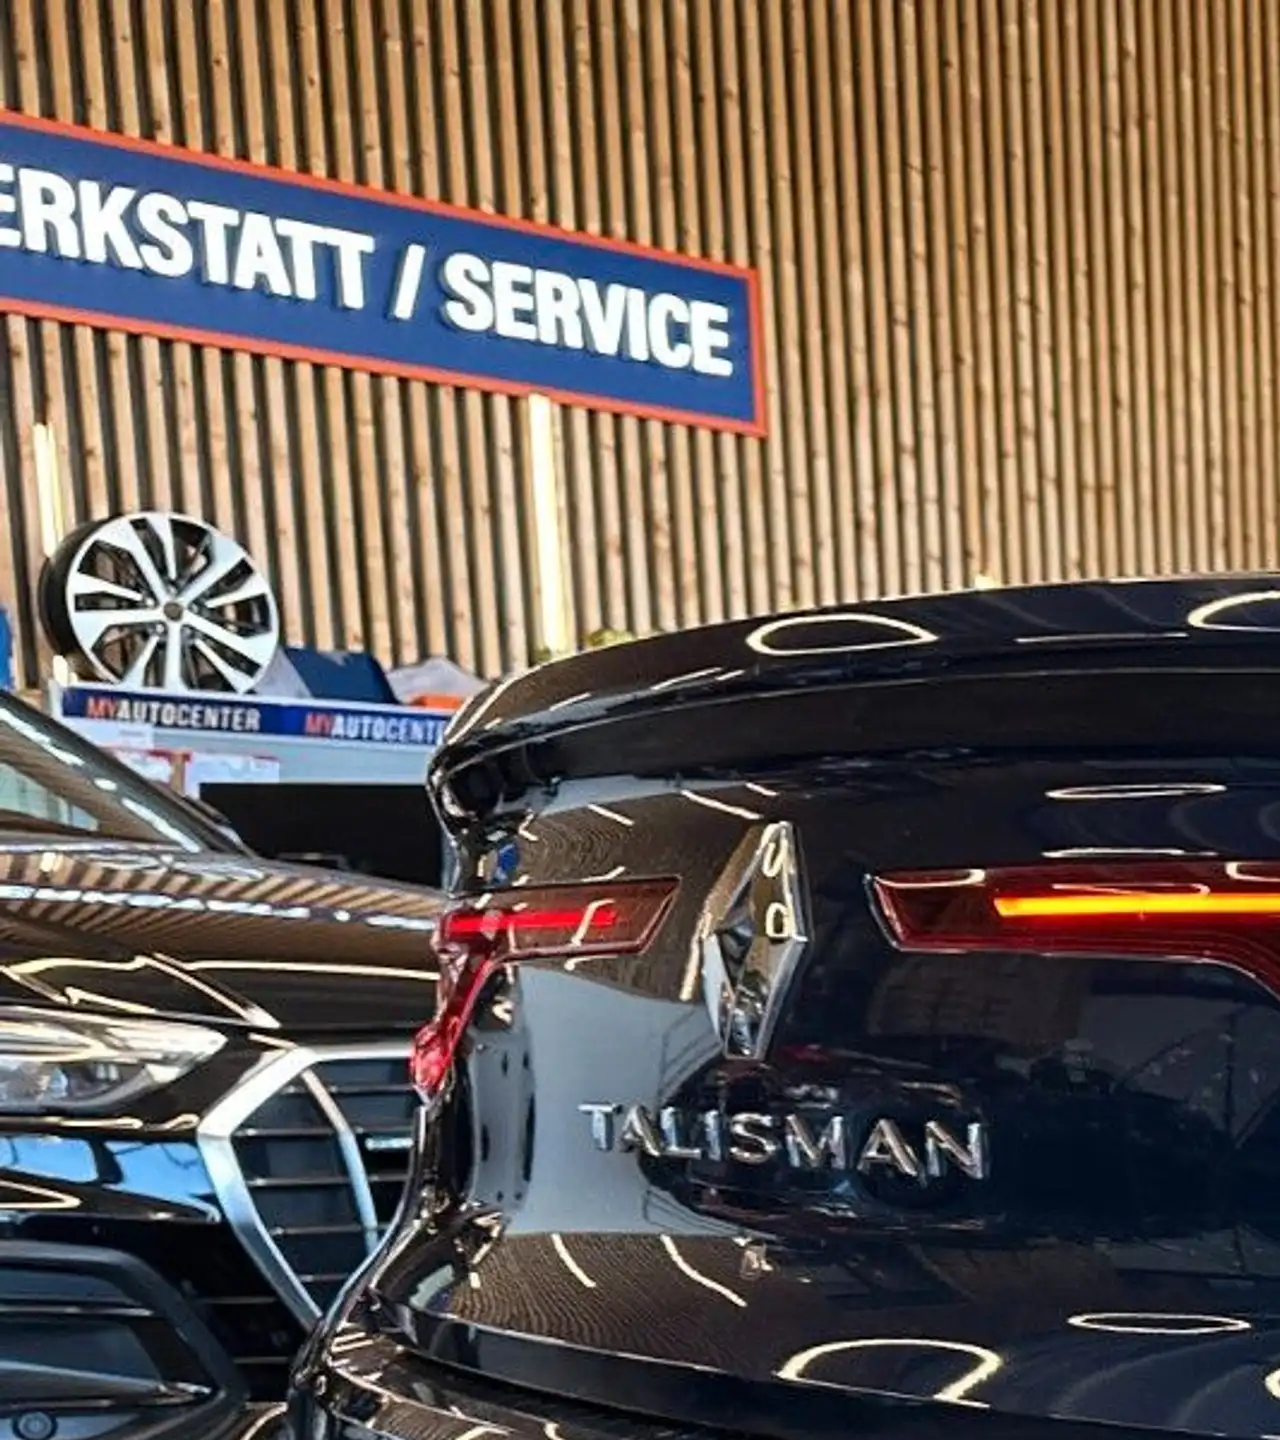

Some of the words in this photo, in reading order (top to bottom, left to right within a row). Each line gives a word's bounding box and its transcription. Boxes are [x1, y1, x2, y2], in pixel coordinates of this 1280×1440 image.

[443, 254, 733, 377] SERVICE
[87, 696, 261, 732] MYAUTOCENTER
[578, 1101, 990, 1182] TALISMAN
